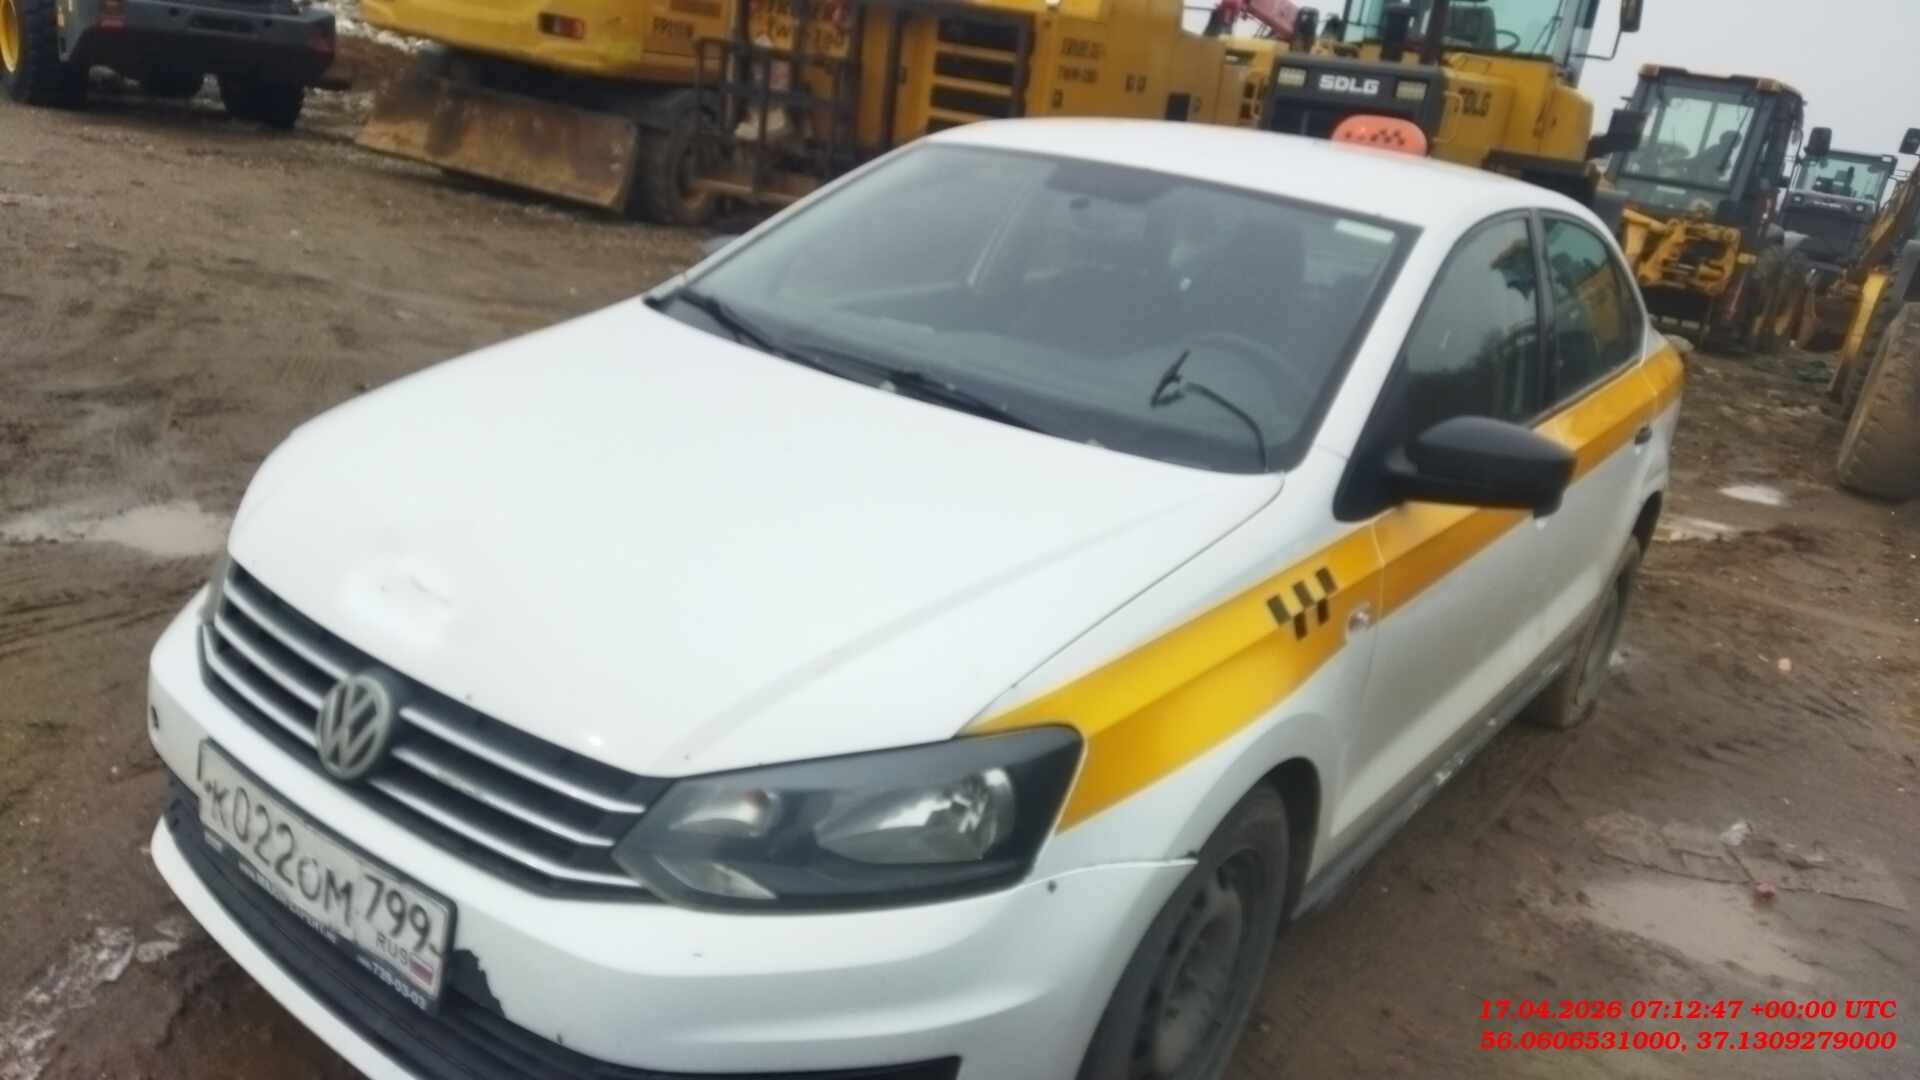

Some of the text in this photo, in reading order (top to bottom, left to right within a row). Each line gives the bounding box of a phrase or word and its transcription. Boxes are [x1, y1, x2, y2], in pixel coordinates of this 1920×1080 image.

[1318, 74, 1380, 95] SDLG
[364, 873, 432, 952] 799
[376, 929, 409, 966] RUS
